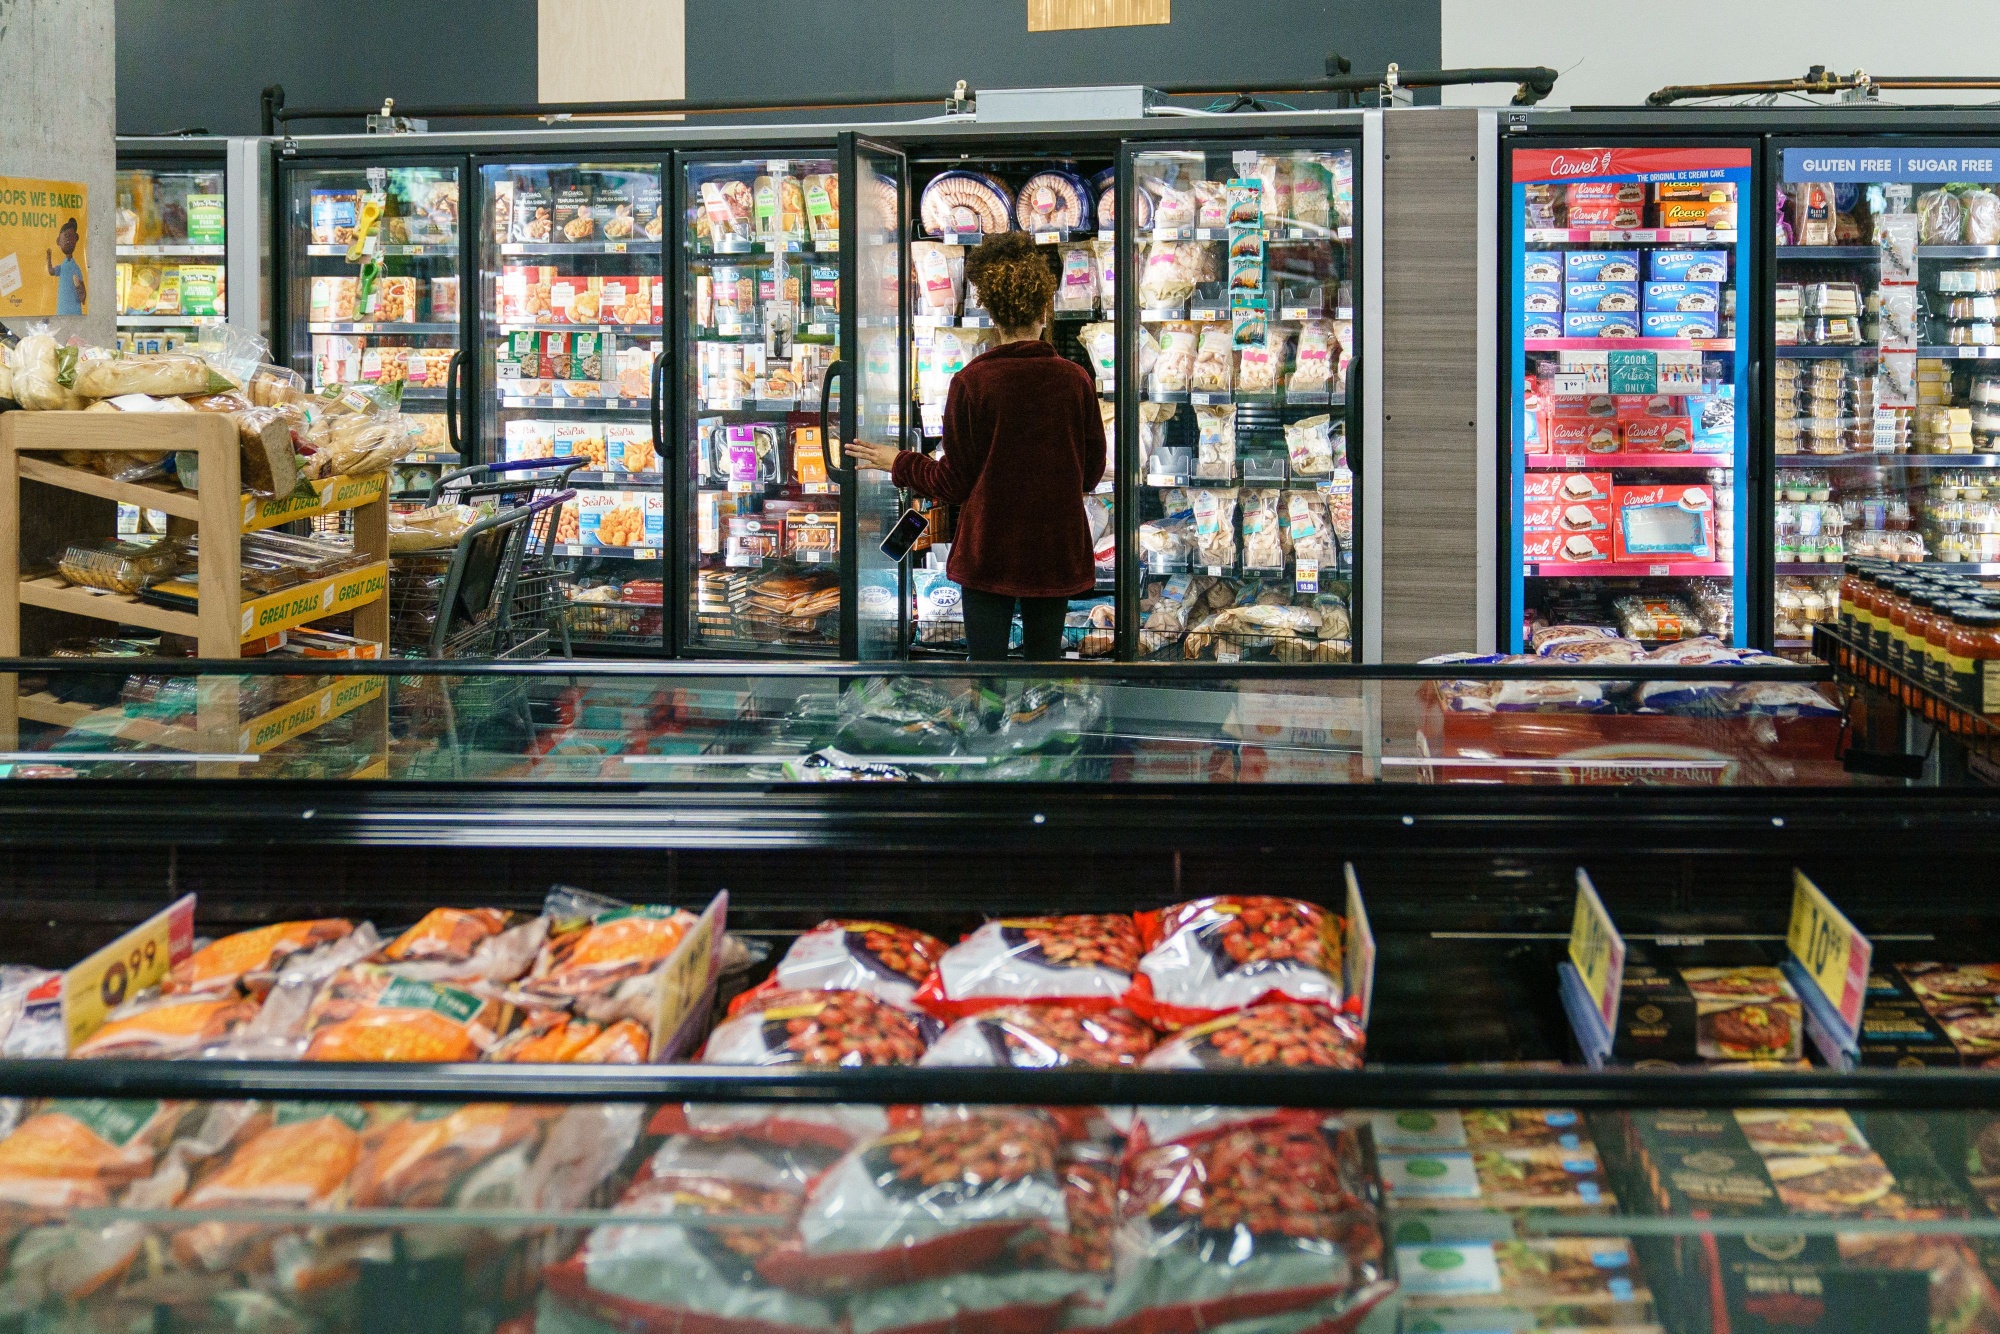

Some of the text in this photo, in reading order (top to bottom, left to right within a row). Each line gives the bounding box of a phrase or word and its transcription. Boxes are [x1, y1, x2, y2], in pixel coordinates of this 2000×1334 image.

[1550, 155, 1599, 176] Carvel
[1802, 159, 1993, 172] GLUTEN FREE SUGAR FREE
[1637, 169, 1725, 182] THE ORIGINAL ICE CREAM CAKE
[0, 189, 83, 209] OPS WE BAKED
[1573, 208, 1601, 220] Carvel
[1668, 205, 1706, 218] Reese's
[0, 211, 57, 228] OO MUCH
[1569, 253, 1606, 266] OREO
[1657, 253, 1694, 266] OREO
[1569, 284, 1606, 296] OREO
[1649, 284, 1686, 296] OREO
[1568, 314, 1606, 327] OREO
[1646, 314, 1684, 327] OREO
[1624, 356, 1647, 364] GOOD
[1621, 366, 1651, 381] vibes
[1625, 384, 1645, 393] ONLY
[556, 427, 585, 437] SeaPak
[609, 428, 635, 437] SeaPak
[1554, 424, 1586, 438] Carvel
[1627, 424, 1658, 437] Carvel
[337, 476, 383, 501] GREAT DEAL
[262, 491, 321, 518] GREAT DEALS
[582, 495, 614, 508] SeaPak
[1623, 491, 1656, 506] Carvel
[338, 575, 385, 602] GREAT DEAL
[934, 589, 958, 597] SEIZE
[259, 594, 319, 626] GREAT DEALS
[335, 683, 363, 706] GREAT
[255, 705, 317, 746] GREAT DEALS
[1580, 766, 1713, 784] PEPPERIDGE FARM
